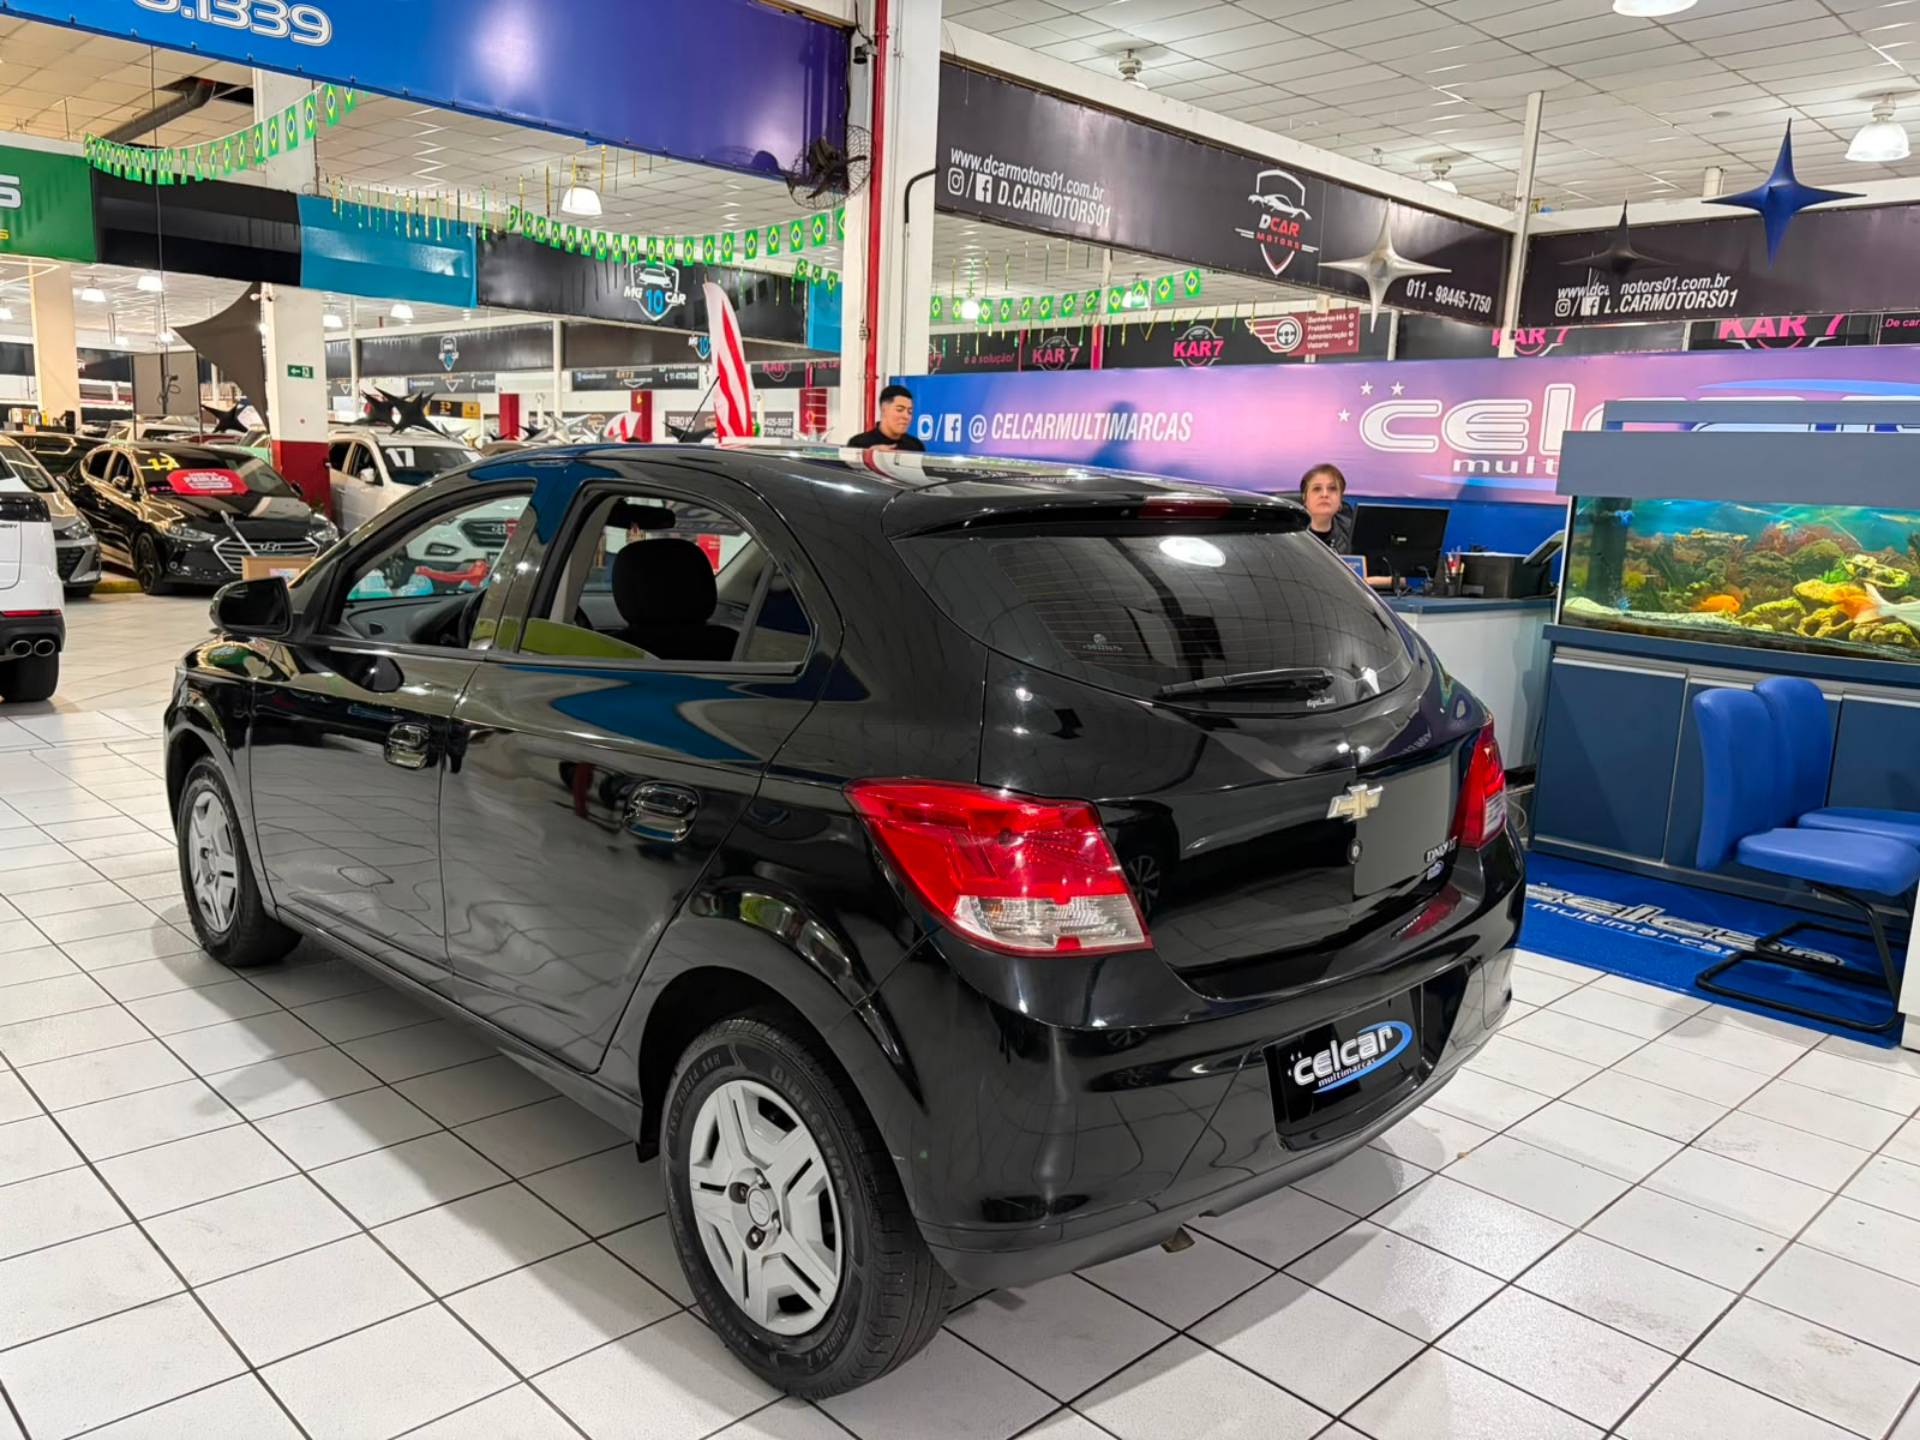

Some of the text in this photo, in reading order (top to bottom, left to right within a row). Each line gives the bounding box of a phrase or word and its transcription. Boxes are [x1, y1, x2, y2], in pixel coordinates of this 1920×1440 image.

[951, 147, 1104, 201] www.dcarmotors01.com.br
[997, 180, 1111, 228] D.CARMOTORS01
[623, 286, 687, 315] MG 10 CAR
[1406, 278, 1426, 300] 011
[1435, 285, 1492, 314] 98445-7750
[1032, 347, 1064, 364] KAR
[991, 411, 1193, 443] CELCARMULTIMARCAS
[385, 447, 415, 468] 17
[1294, 1025, 1393, 1086] celcar
[1318, 1058, 1376, 1087] multimarcas
